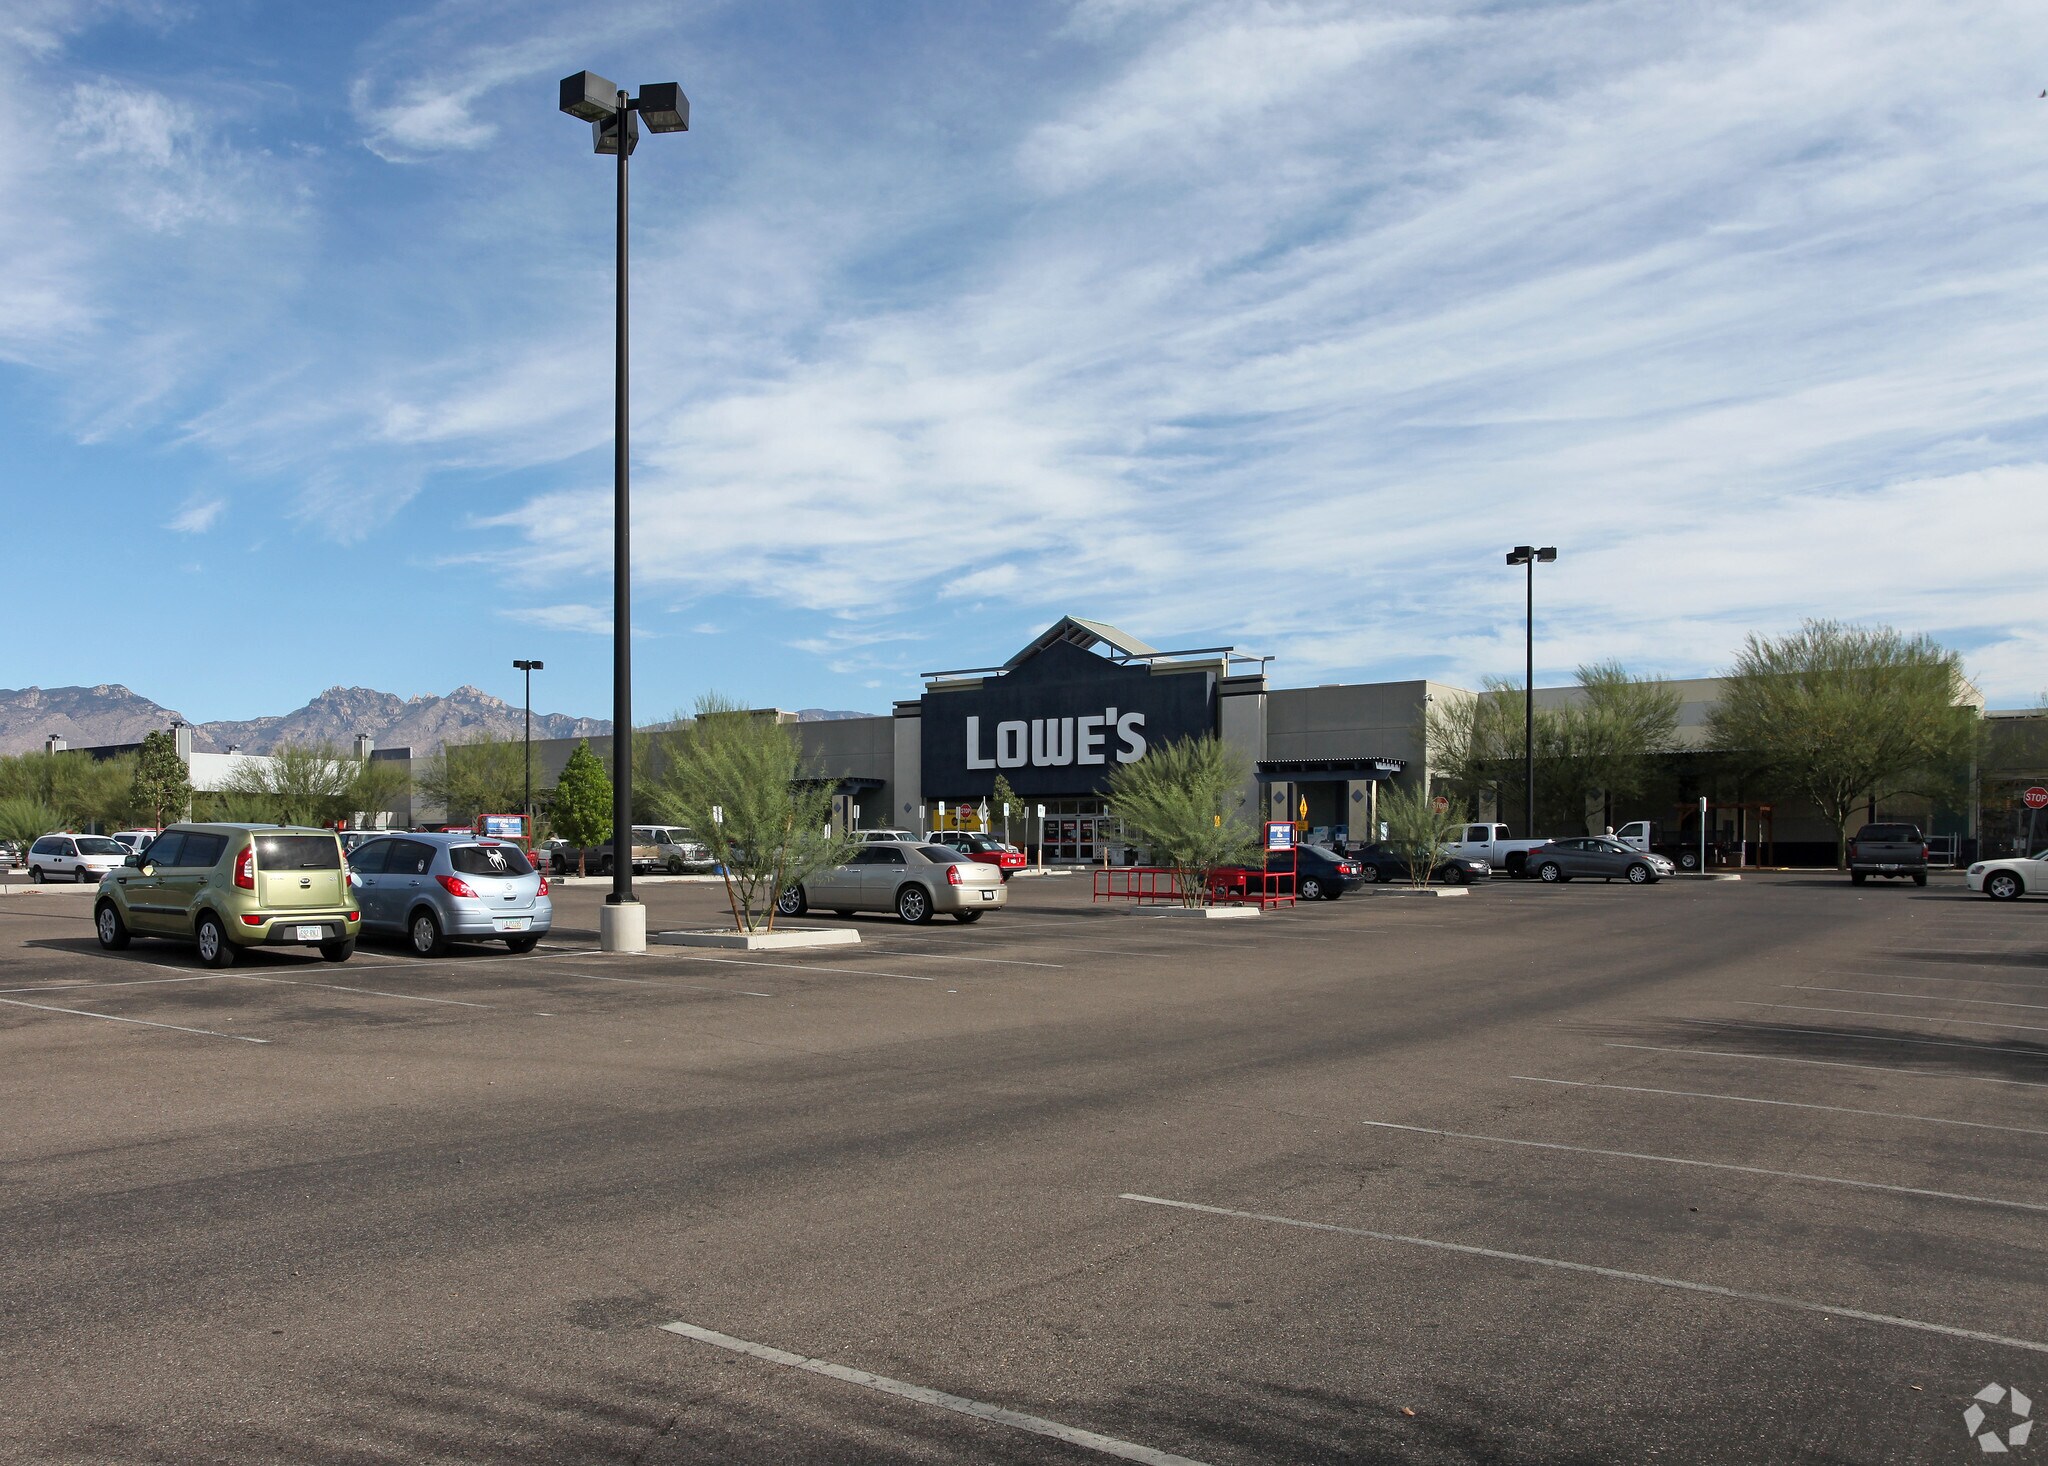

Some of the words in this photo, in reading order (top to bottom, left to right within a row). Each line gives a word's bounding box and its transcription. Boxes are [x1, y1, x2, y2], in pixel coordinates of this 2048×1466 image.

[966, 707, 1147, 770] LOWE'S
[2025, 793, 2047, 802] STOP
[1432, 801, 1447, 809] STOP
